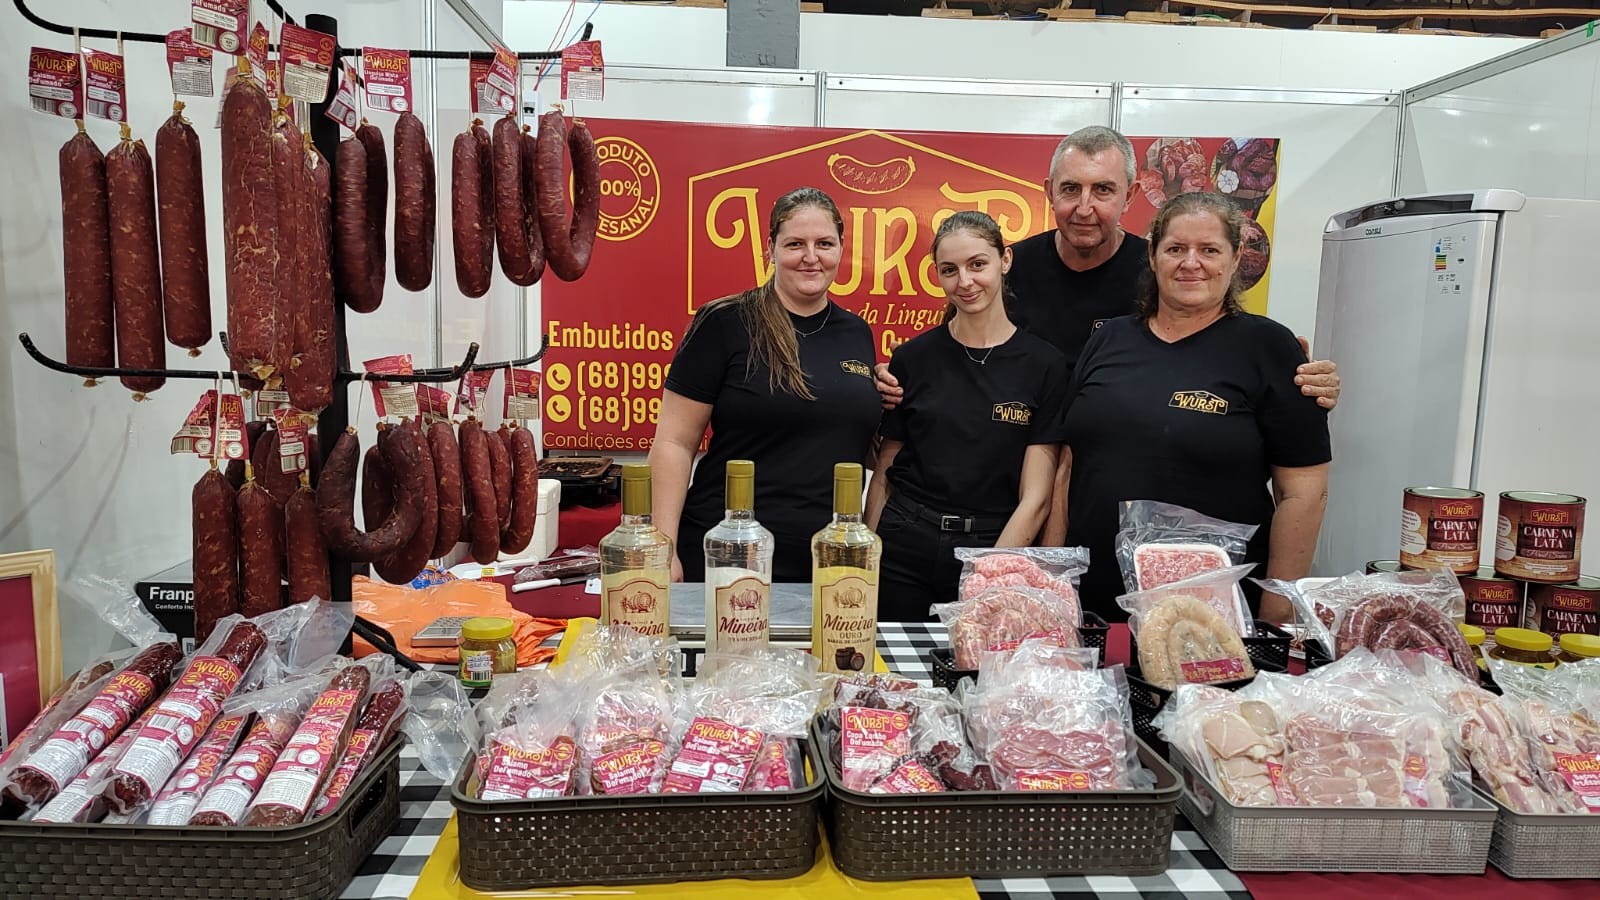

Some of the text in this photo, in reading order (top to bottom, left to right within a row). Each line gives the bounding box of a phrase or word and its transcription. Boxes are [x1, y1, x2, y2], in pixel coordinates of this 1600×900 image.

[32, 54, 78, 73] WURST
[86, 55, 122, 75] WURST
[365, 55, 407, 72] WURST
[597, 143, 651, 177] ODUTO
[600, 179, 641, 197] 00%
[598, 196, 655, 234] ESANAL
[858, 303, 948, 330] da Lingui
[548, 320, 674, 351] Embutidos
[1174, 393, 1226, 413] WURST
[578, 395, 662, 431] (68)99
[543, 432, 634, 449] Condições
[1441, 504, 1473, 516] WURST
[1532, 511, 1567, 523] WURST
[1433, 520, 1467, 531] CARNE
[1524, 526, 1573, 539] CARNE NA
[1443, 530, 1470, 541] LATA
[1534, 537, 1563, 549] LATA
[149, 586, 194, 604] Franp
[1480, 588, 1513, 600] WURST
[1555, 595, 1590, 608] WURST
[1472, 603, 1506, 615] CARNE
[1547, 609, 1597, 624] CARNE NA
[719, 616, 768, 634] Mineira
[824, 613, 873, 631] Mineira
[1482, 614, 1509, 625] LATA
[1557, 621, 1586, 633] LATA
[193, 661, 238, 686] WURST
[848, 714, 890, 731] WURST
[695, 723, 738, 742] WURST
[846, 730, 863, 739] Copa
[493, 766, 532, 778] Defumado
[1560, 756, 1600, 773] WURS
